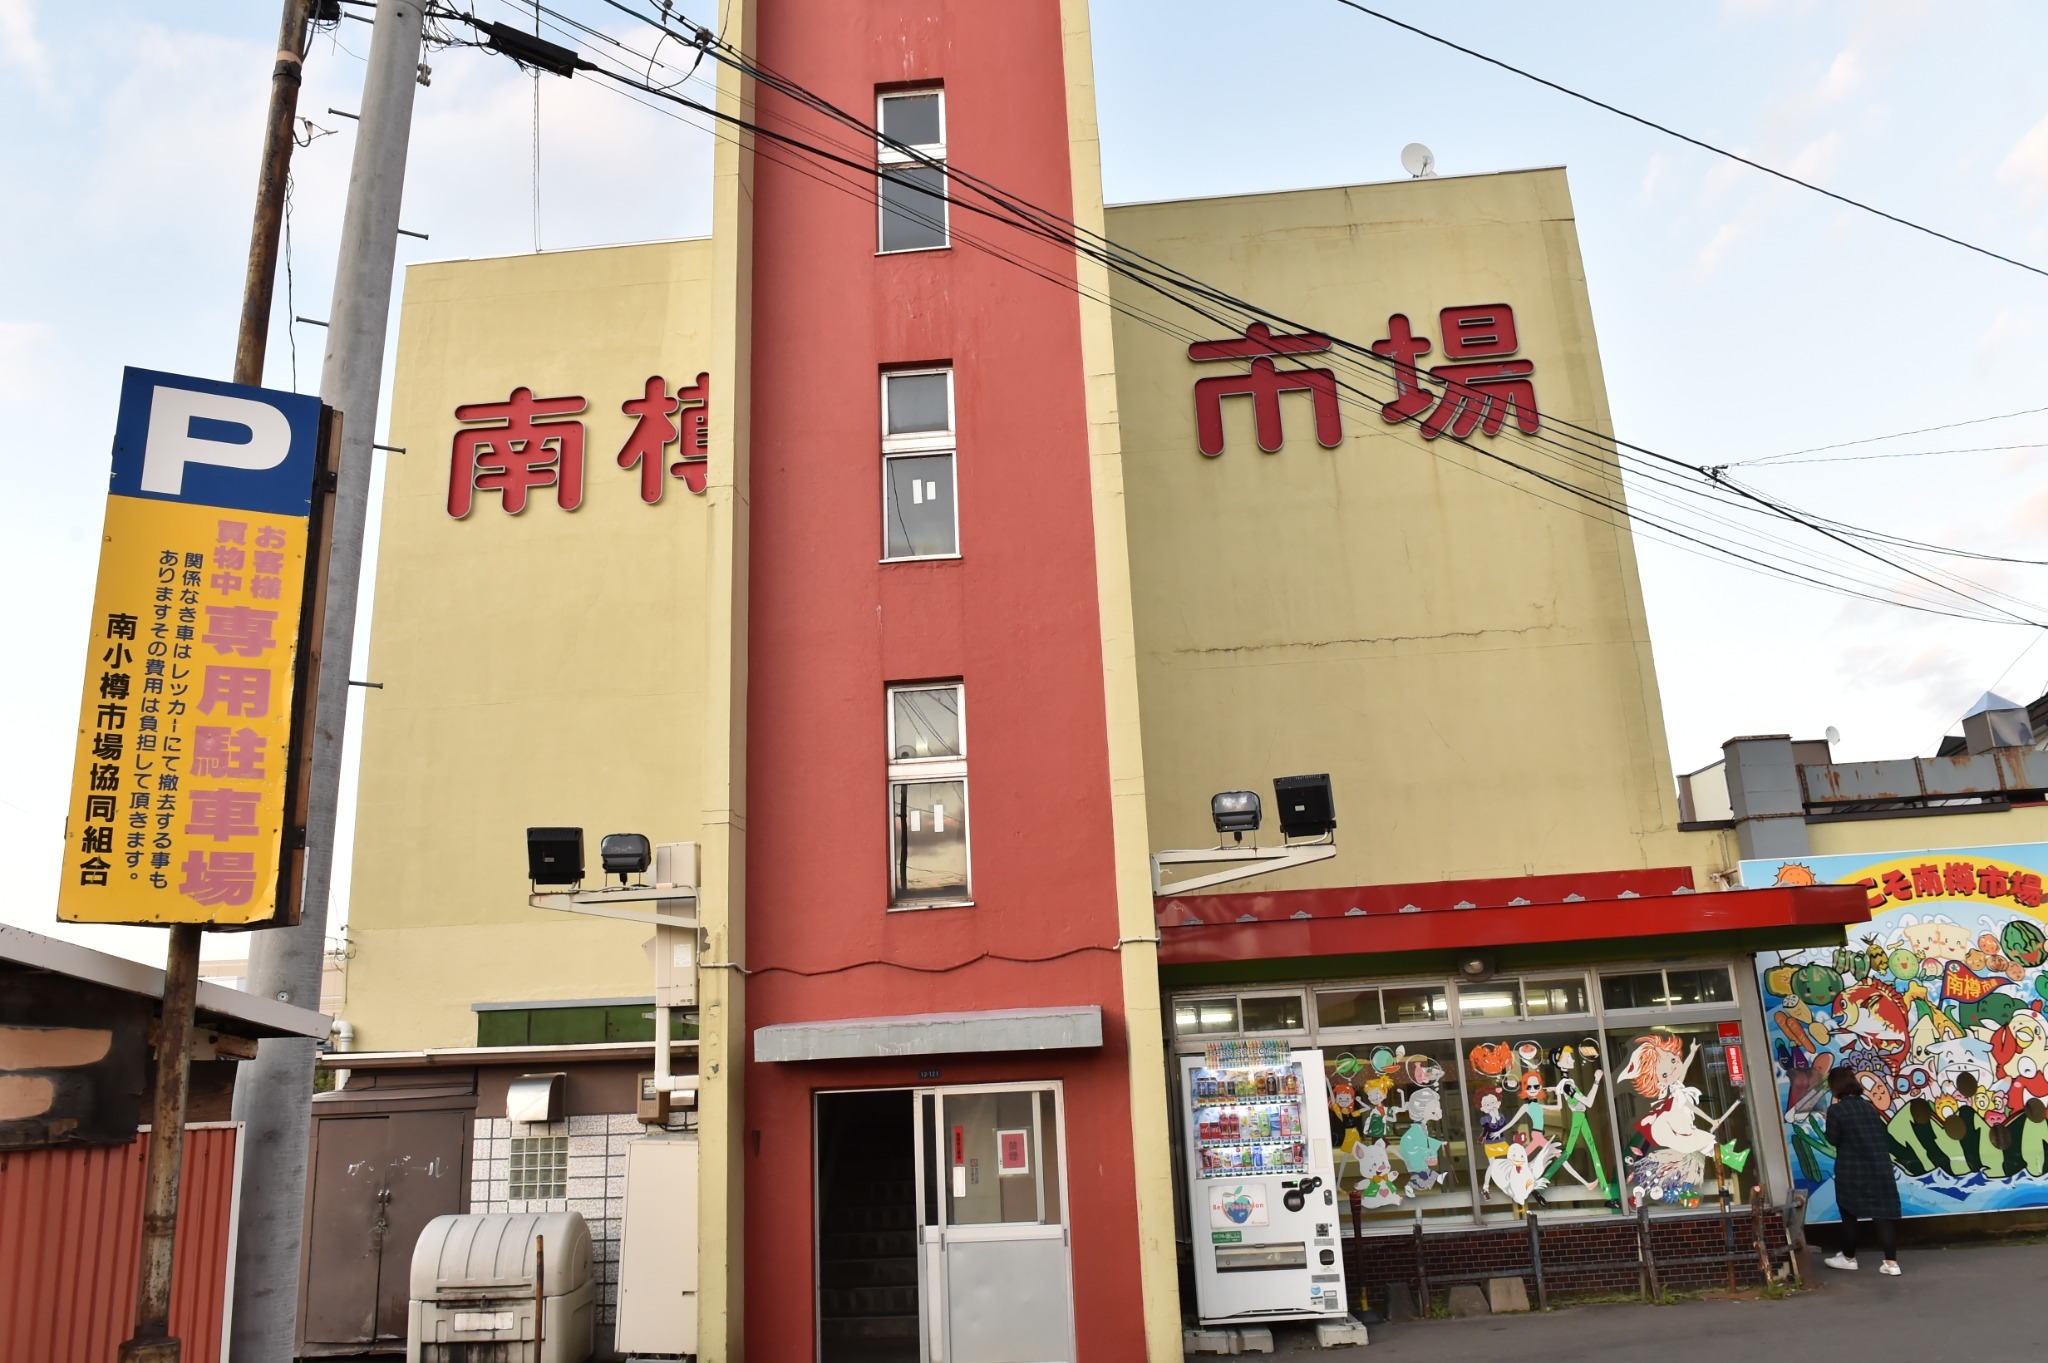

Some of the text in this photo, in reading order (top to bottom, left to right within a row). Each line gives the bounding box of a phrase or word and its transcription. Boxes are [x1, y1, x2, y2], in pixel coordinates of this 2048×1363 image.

[140, 384, 292, 496] P
[447, 302, 1541, 520] 南樽 市場
[210, 519, 249, 596] 買物中
[250, 525, 286, 600] お客様
[80, 612, 138, 887] 南小樽市場協同組合
[178, 605, 279, 908] 専用駐車場
[1856, 862, 2048, 909] こそ南樽市場
